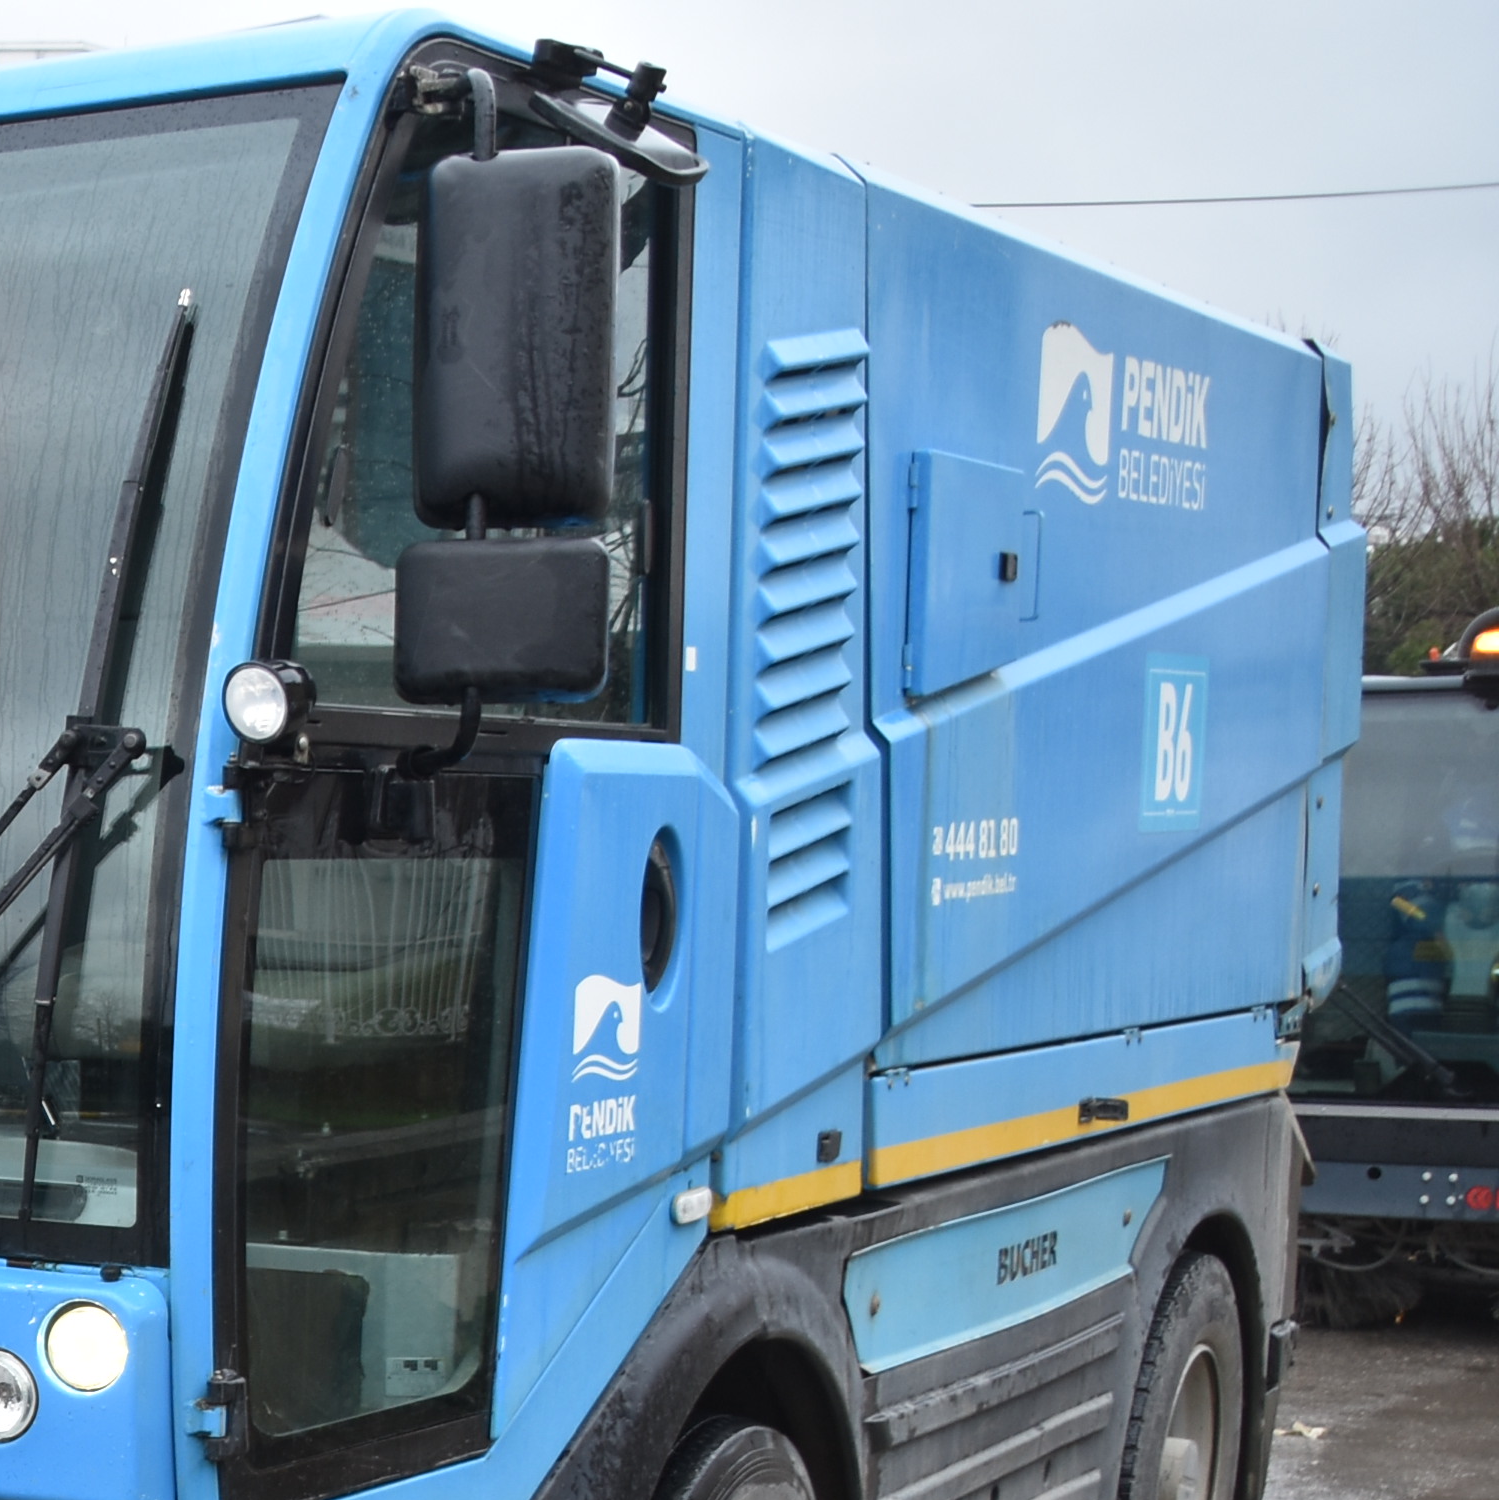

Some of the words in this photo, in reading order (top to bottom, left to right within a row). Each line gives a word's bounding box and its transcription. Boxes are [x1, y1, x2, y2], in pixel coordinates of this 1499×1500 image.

[1154, 682, 1193, 802] B6
[945, 821, 975, 861] 444
[979, 819, 996, 859] 81
[1000, 818, 1018, 856] 80
[997, 1230, 1057, 1286] BUCHER
